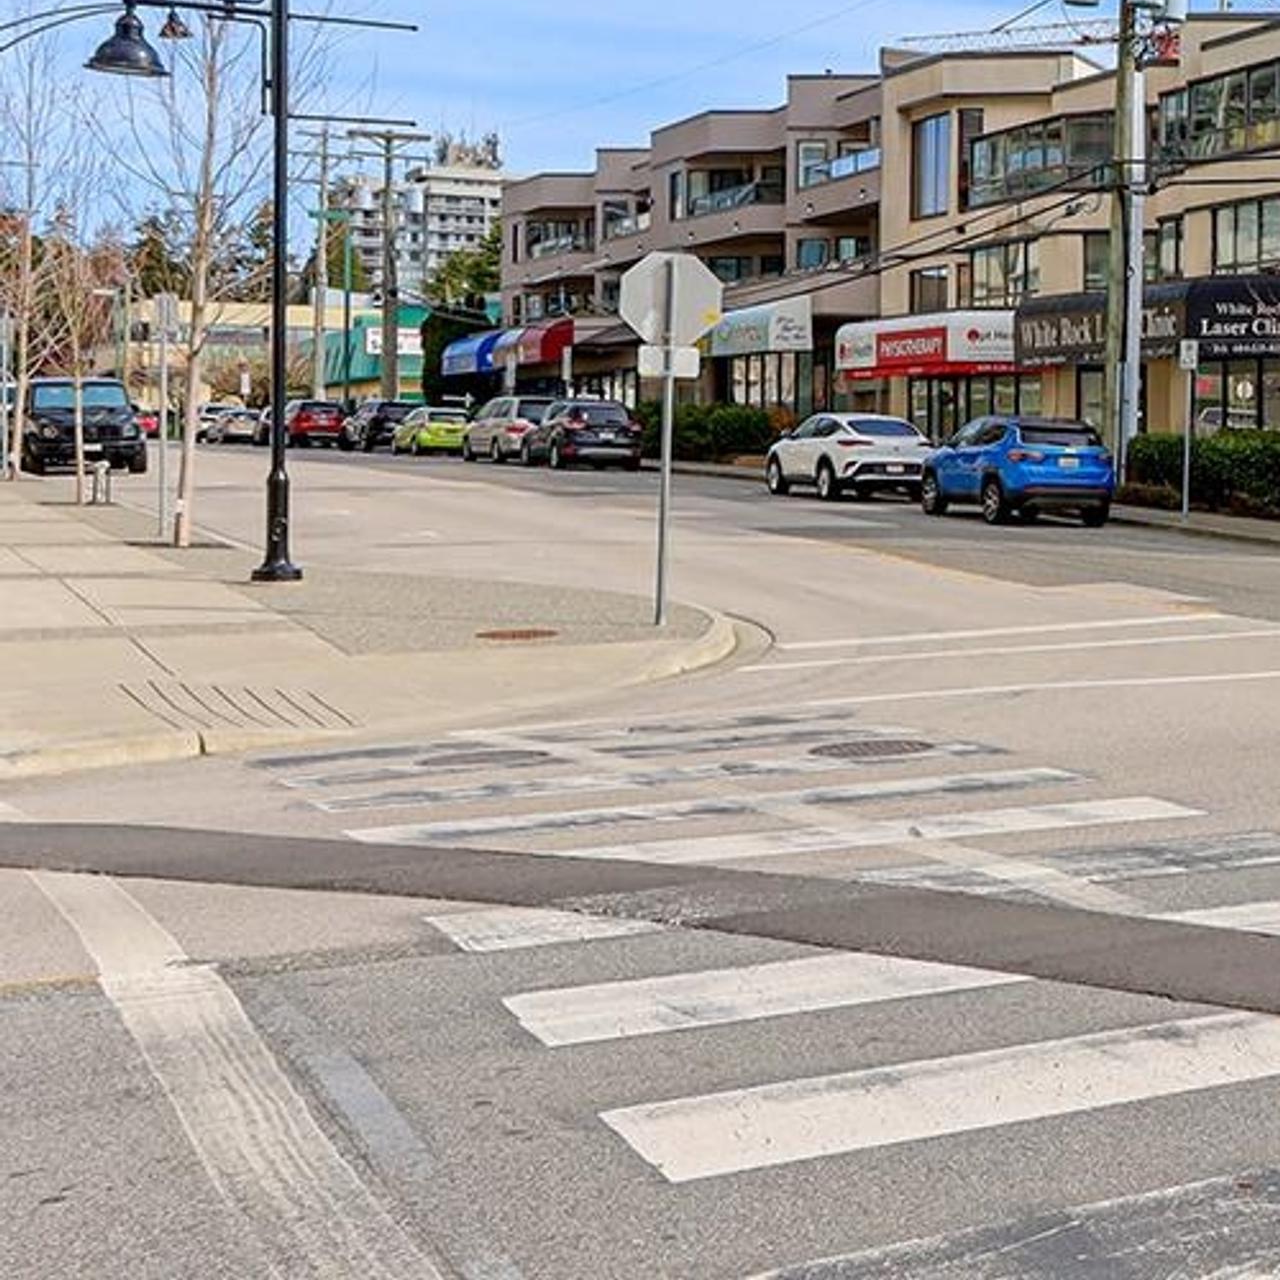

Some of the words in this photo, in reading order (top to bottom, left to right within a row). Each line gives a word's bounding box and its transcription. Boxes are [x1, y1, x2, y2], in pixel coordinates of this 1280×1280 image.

[1215, 302, 1253, 316] White
[1020, 320, 1057, 349] White
[1059, 315, 1092, 346] Rock
[1200, 318, 1249, 336] Laser
